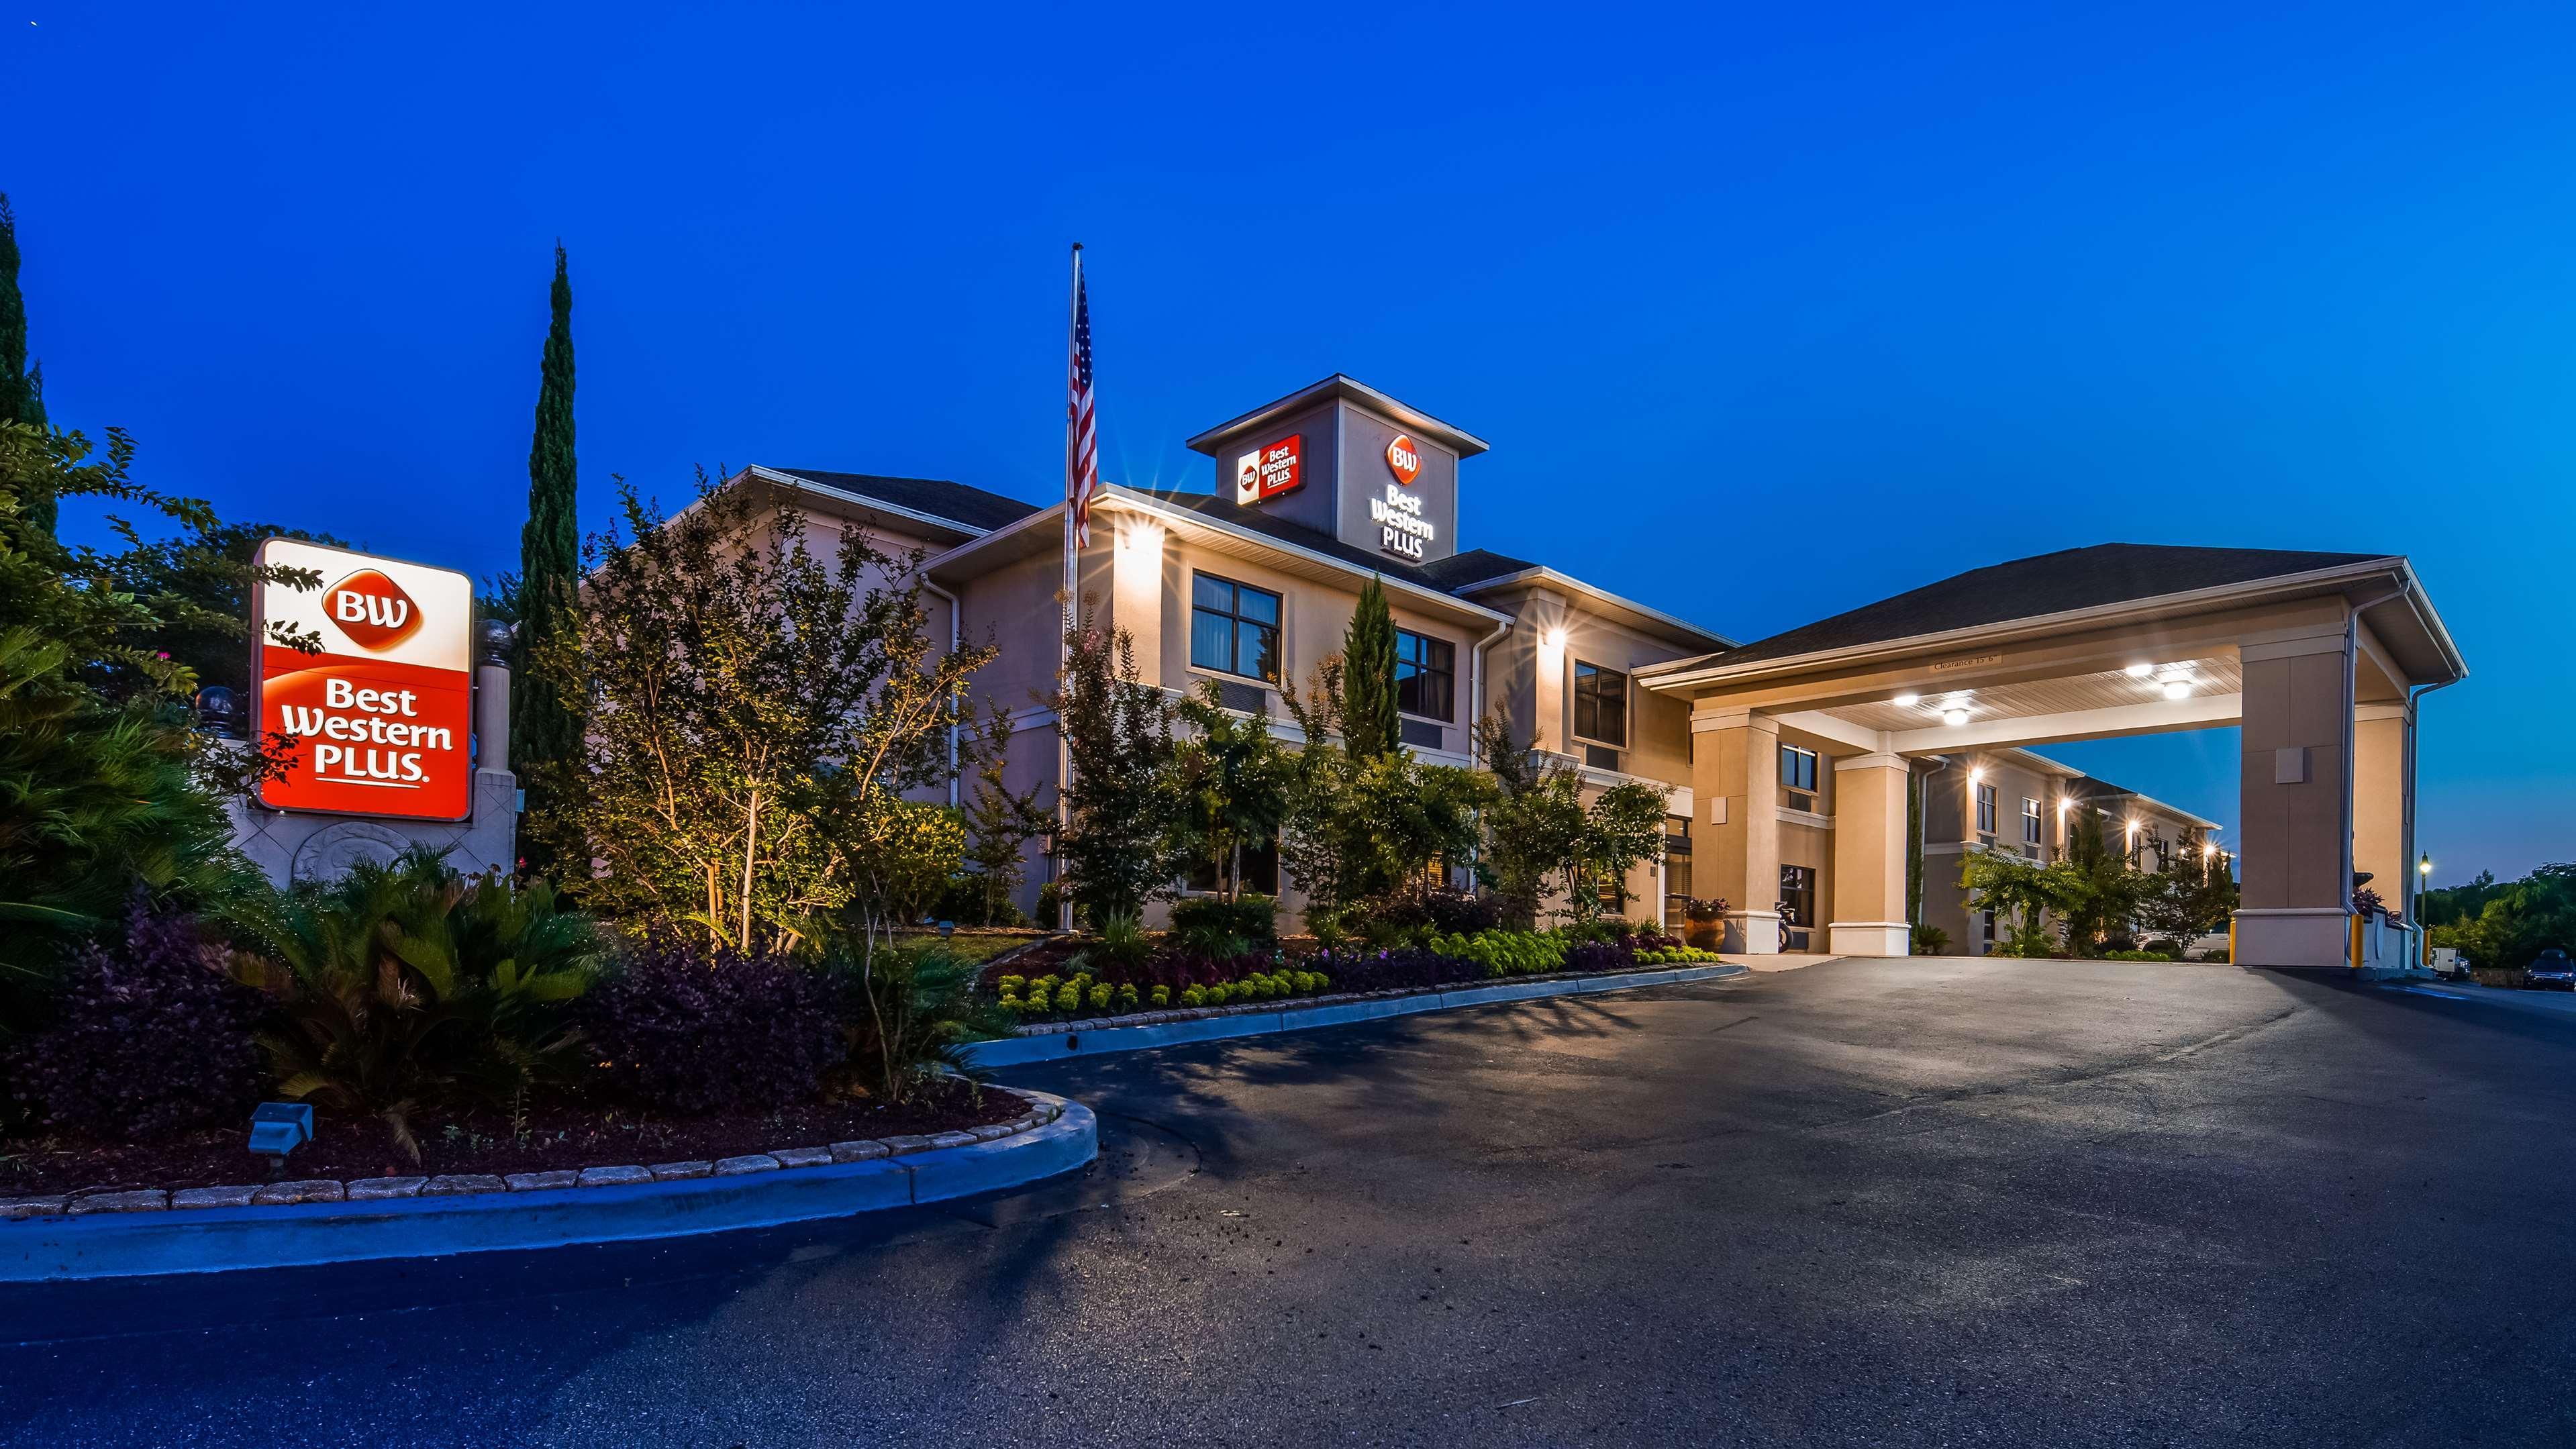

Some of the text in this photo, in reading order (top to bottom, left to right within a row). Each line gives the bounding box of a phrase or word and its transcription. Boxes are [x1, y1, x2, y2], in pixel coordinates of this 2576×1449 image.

[1261, 455, 1297, 476] Western
[1269, 446, 1289, 462] Best
[1392, 446, 1417, 472] BW
[1242, 470, 1256, 485] BW
[1387, 484, 1421, 515] Best
[1371, 498, 1434, 540] Western
[1383, 526, 1423, 558] PLUS
[336, 590, 408, 628] BW
[1934, 660, 1973, 670] Clearance
[326, 679, 417, 717] Best
[281, 705, 453, 751] Western
